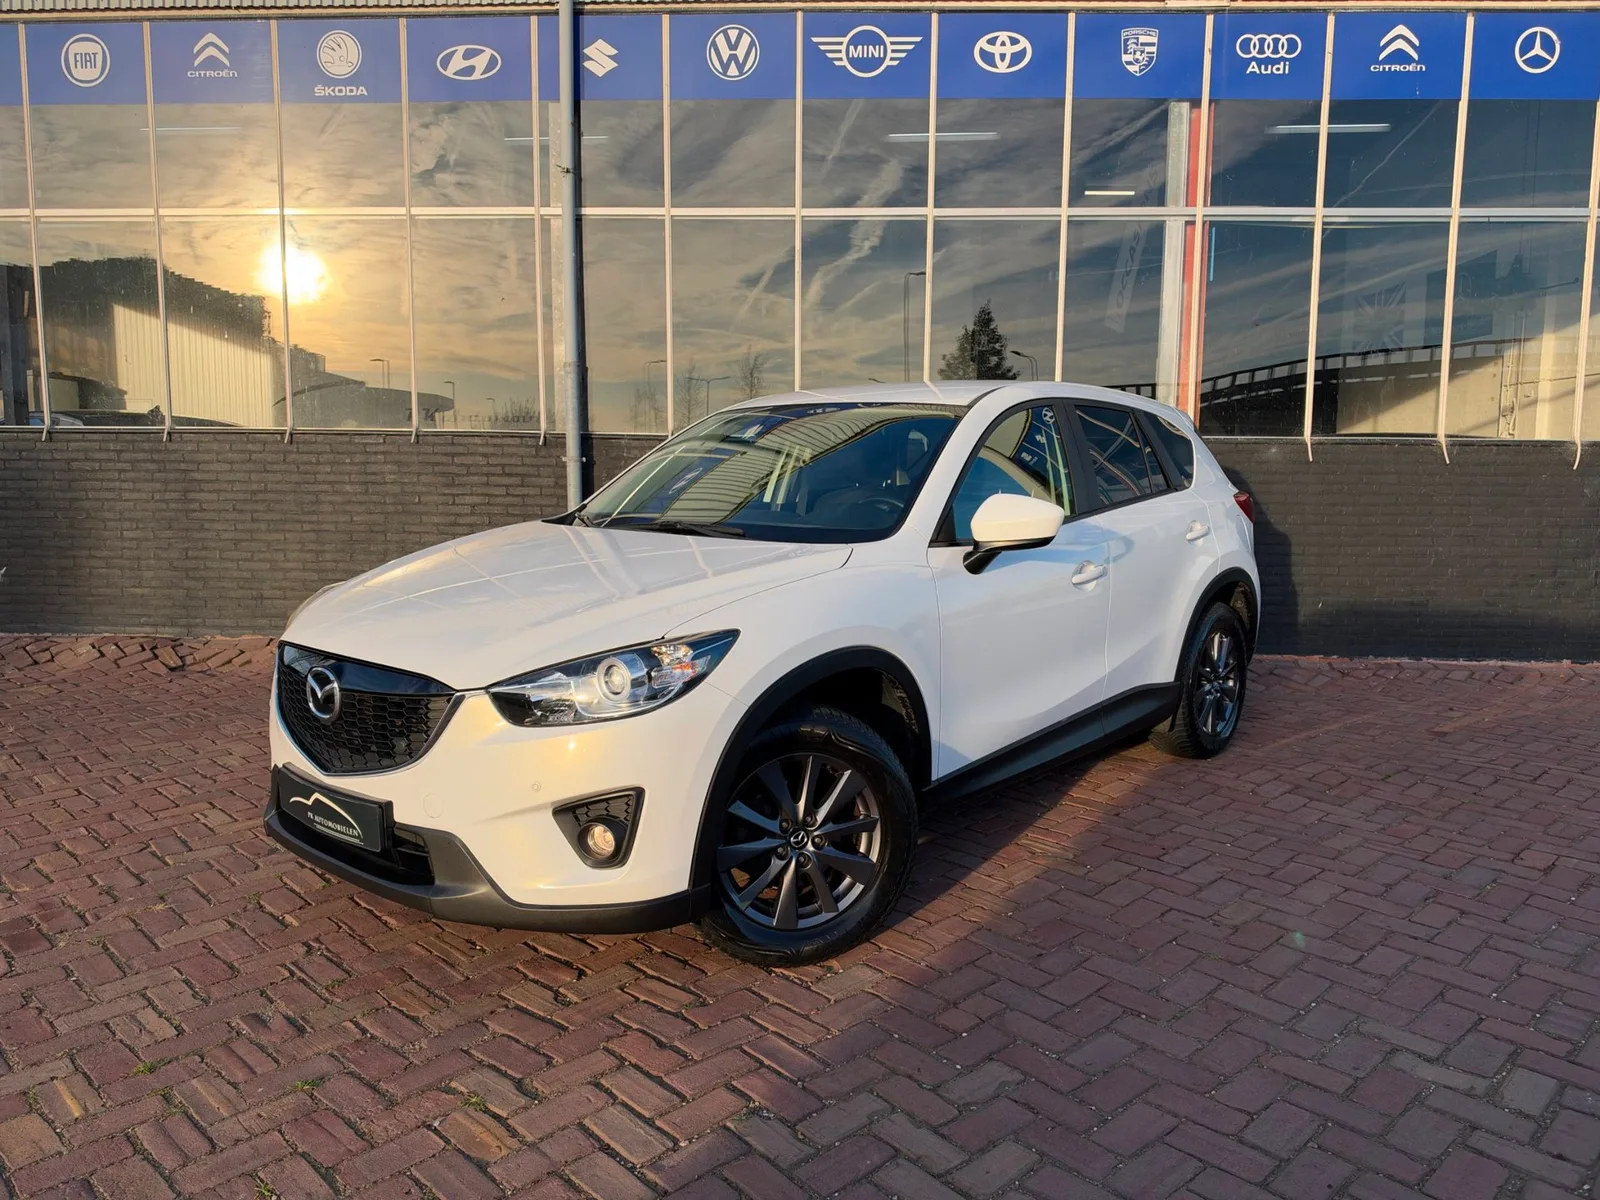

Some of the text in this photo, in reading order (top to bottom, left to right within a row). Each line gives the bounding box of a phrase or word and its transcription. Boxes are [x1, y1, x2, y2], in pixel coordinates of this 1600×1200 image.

[849, 45, 884, 58] MINI
[73, 52, 98, 69] FIAT
[1246, 61, 1290, 75] Audi
[313, 84, 368, 96] ŠKODA
[314, 815, 359, 837] AUTOMOBIELEN
